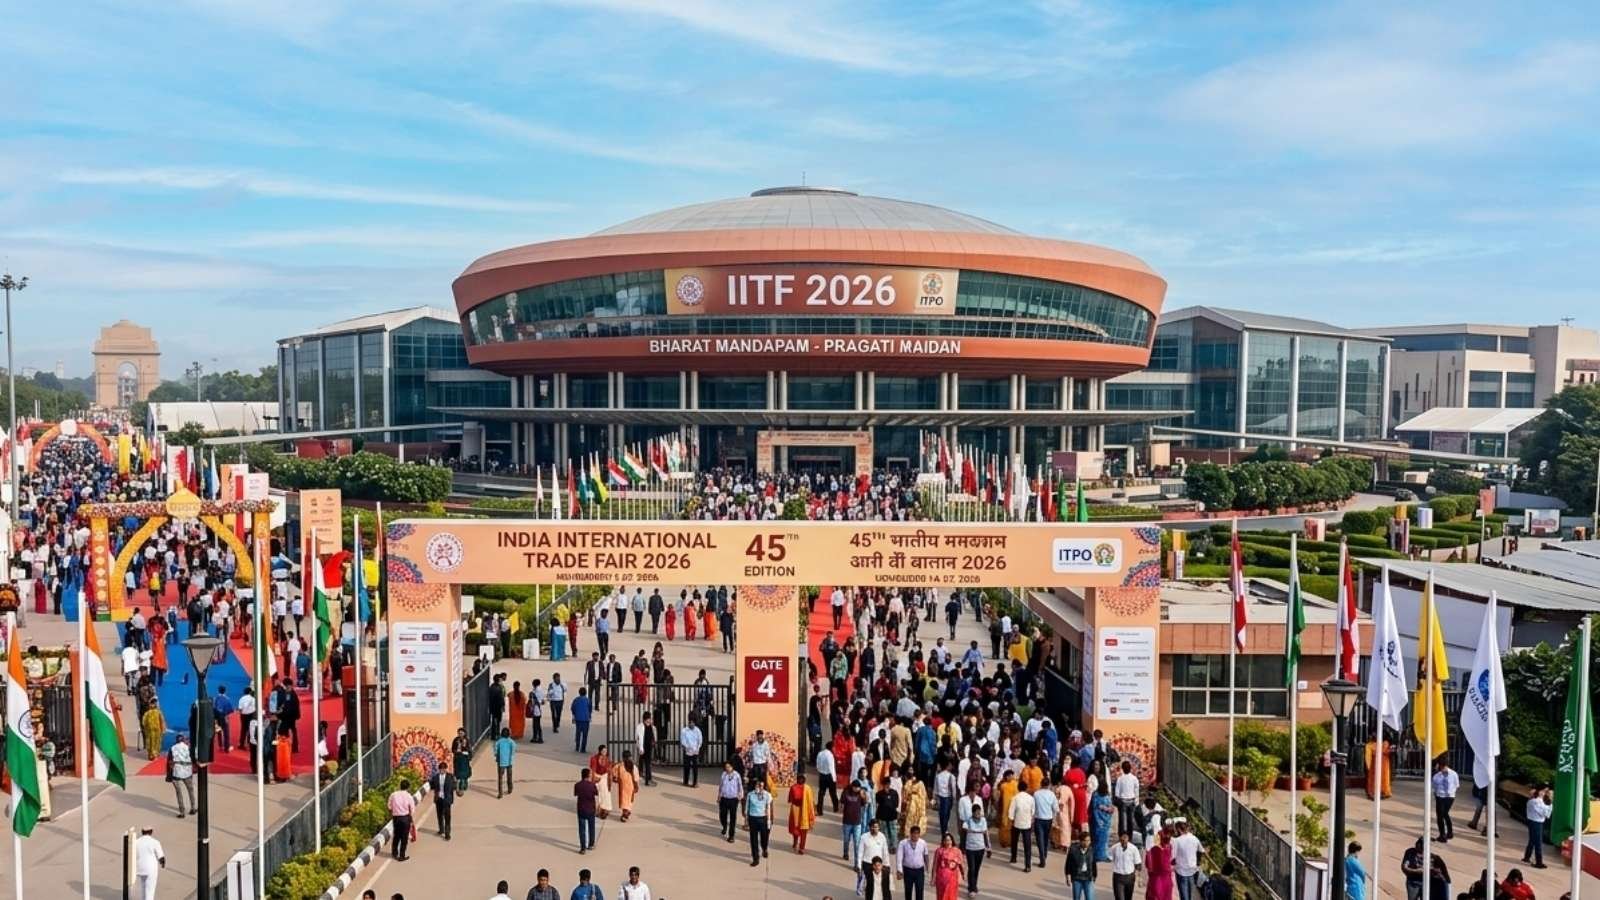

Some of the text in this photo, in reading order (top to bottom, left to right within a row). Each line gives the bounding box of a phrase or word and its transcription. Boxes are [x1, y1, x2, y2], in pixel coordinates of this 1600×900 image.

[727, 274, 897, 306] IITF 2026
[650, 339, 711, 353] BHARAT
[716, 339, 809, 353] MANDAPAM
[824, 340, 894, 353] PRAGATI
[900, 340, 961, 354] MAIDAN
[498, 532, 717, 549] INDIA INTERNATIONAL
[523, 552, 691, 569] TRADE FAIR 2026
[962, 555, 1007, 570] 2026
[1059, 549, 1092, 561] ITPO
[744, 565, 795, 577] EDITION
[751, 659, 783, 670] GATE
[757, 674, 777, 698] 4
